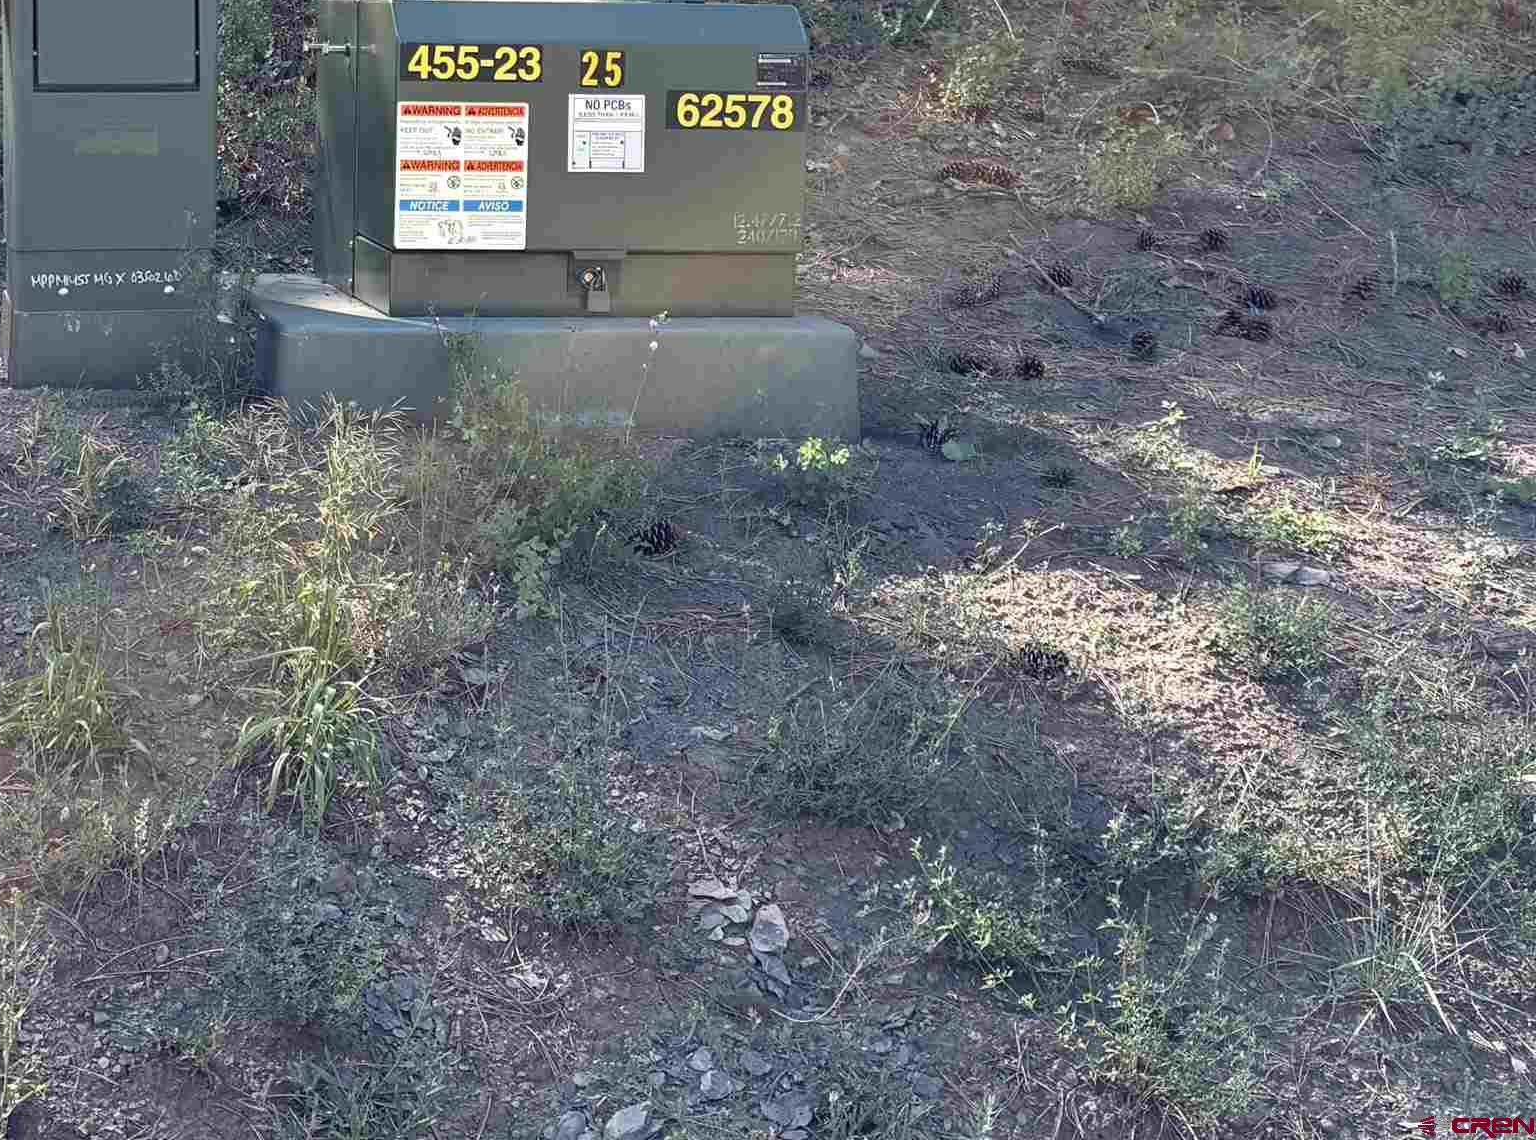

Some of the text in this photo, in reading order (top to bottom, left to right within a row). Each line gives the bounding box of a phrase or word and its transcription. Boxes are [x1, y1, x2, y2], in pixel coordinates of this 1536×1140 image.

[407, 44, 542, 81] 455-23
[580, 50, 623, 88] 25
[412, 105, 461, 116] WARNING
[585, 99, 632, 110] NO PCBs
[676, 93, 794, 129] 62578
[411, 160, 461, 172] WARNING
[409, 200, 449, 212] NOTICE
[478, 200, 509, 212] AVISO
